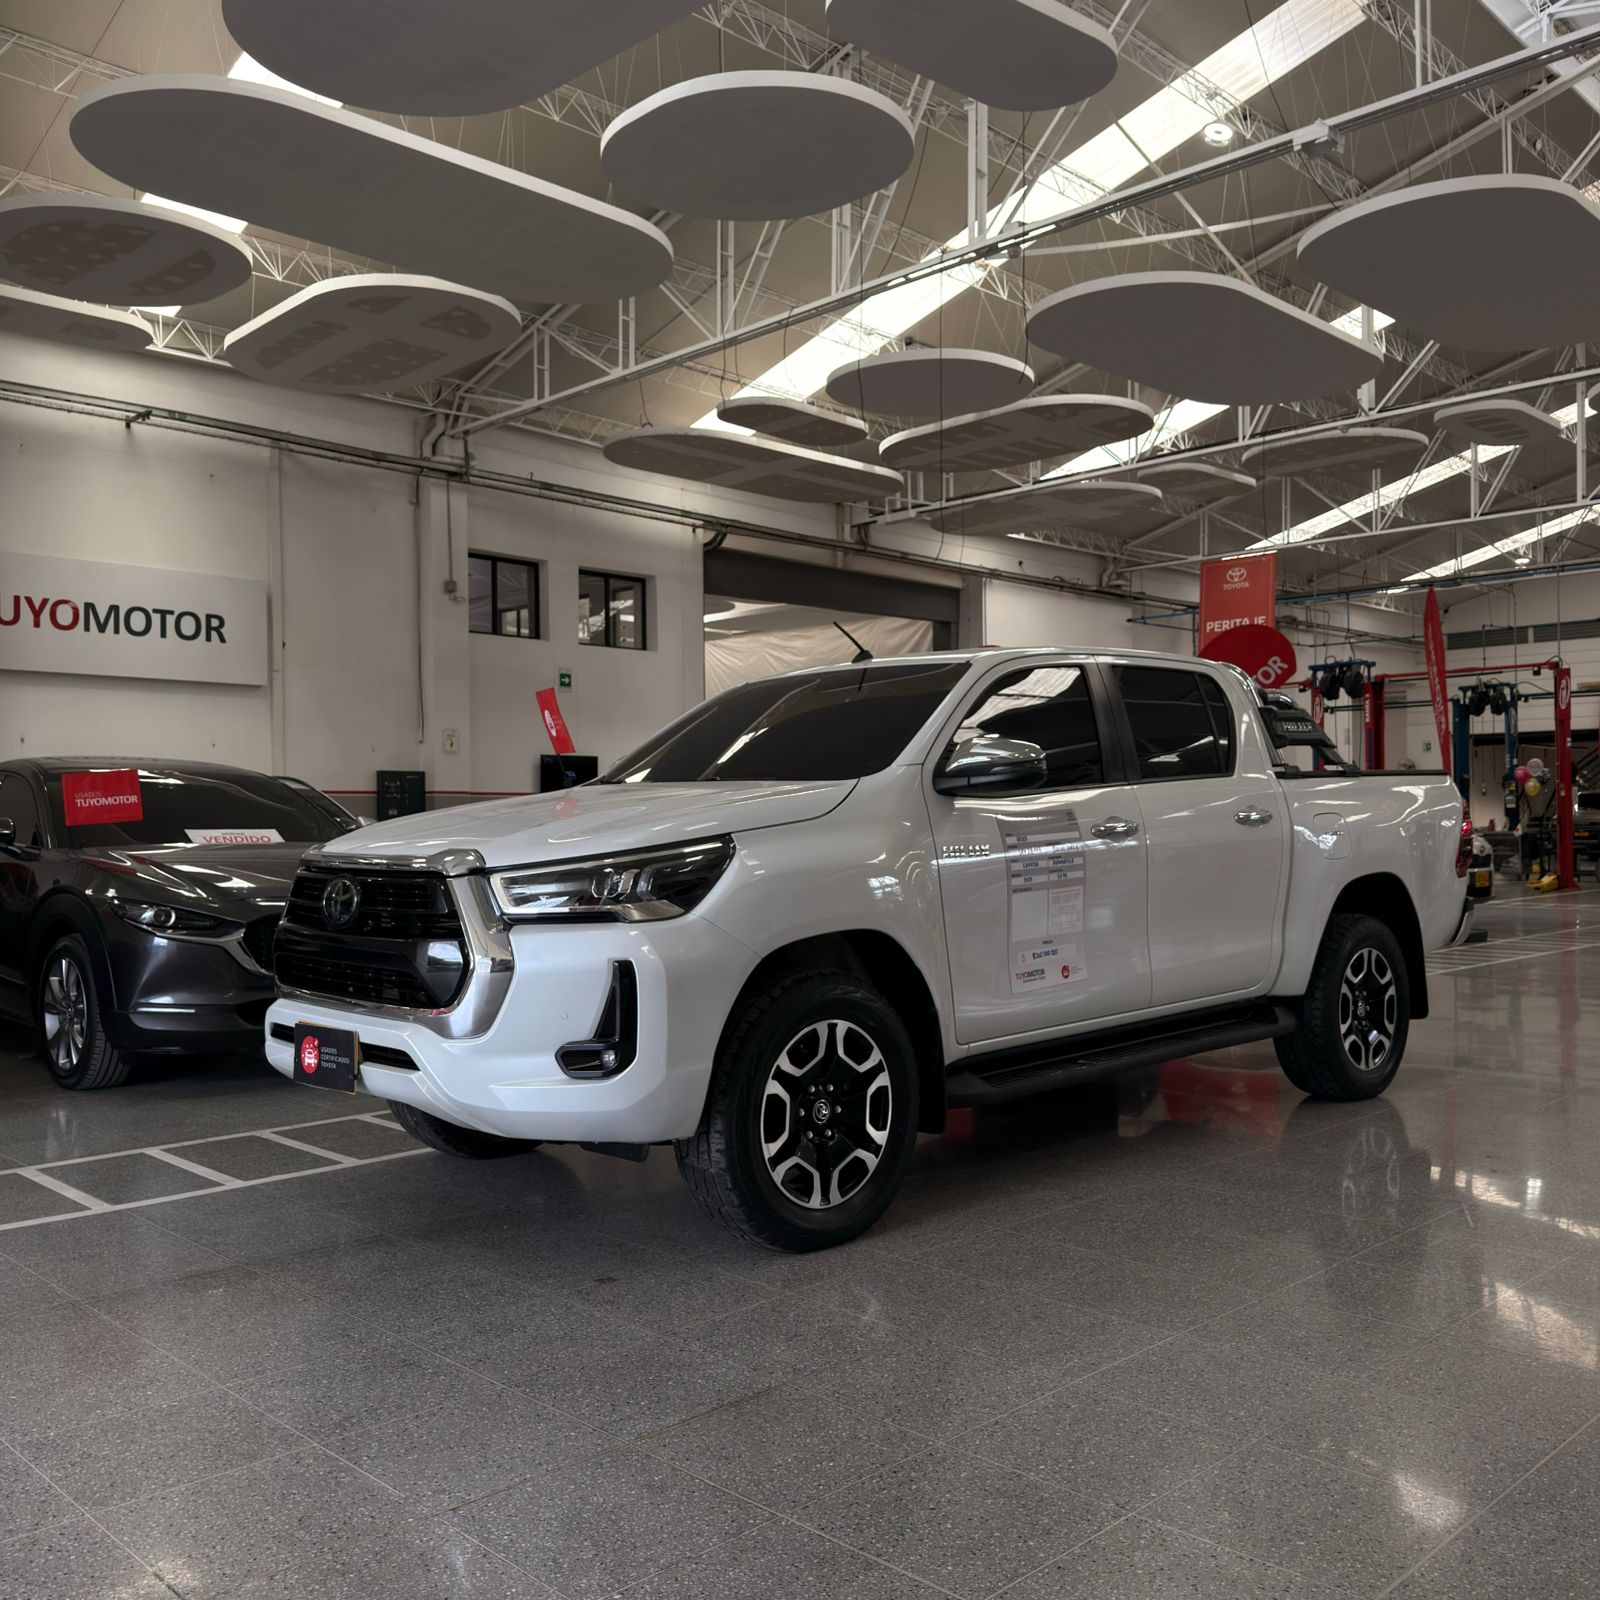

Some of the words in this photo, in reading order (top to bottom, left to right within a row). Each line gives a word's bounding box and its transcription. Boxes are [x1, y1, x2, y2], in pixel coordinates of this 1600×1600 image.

[1223, 582, 1249, 591] TOYOTA
[75, 795, 139, 808] TUYOMOTOR
[203, 835, 271, 844] VENDIDO
[320, 1046, 338, 1055] USADOS
[320, 1053, 350, 1065] CERTIFICADOS
[320, 1061, 337, 1069] TOYOTA
